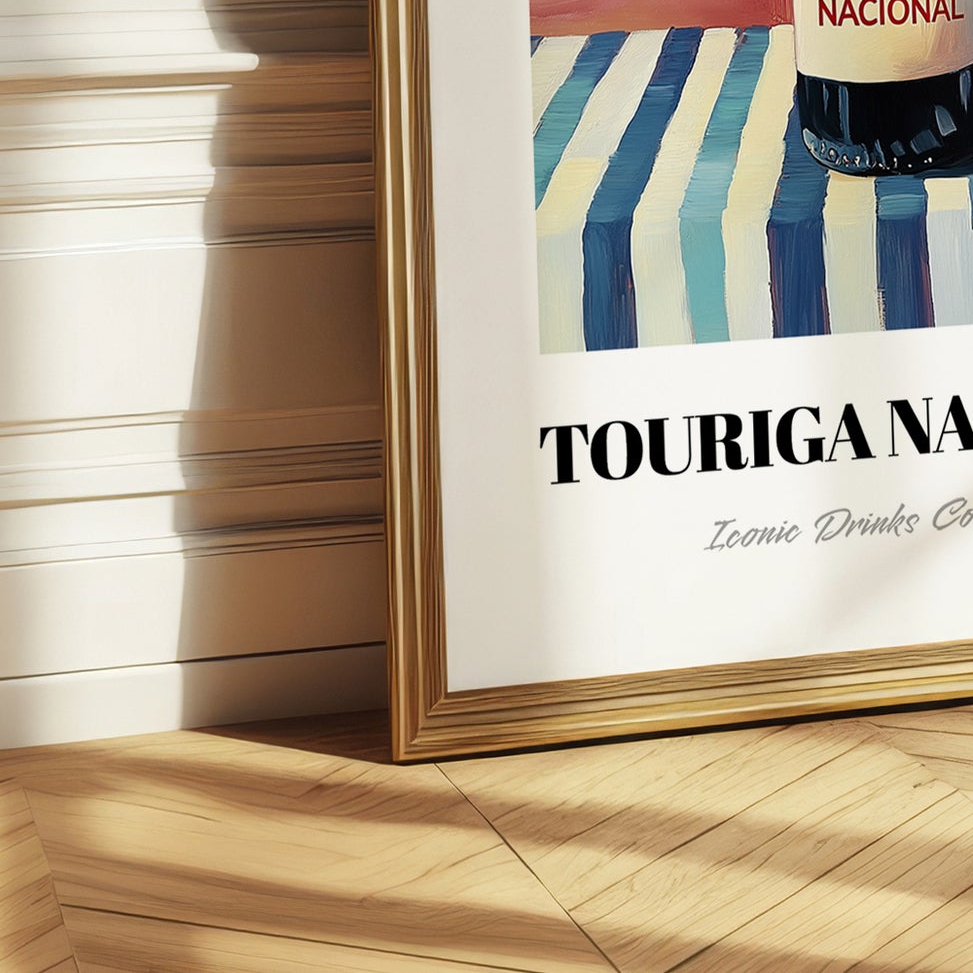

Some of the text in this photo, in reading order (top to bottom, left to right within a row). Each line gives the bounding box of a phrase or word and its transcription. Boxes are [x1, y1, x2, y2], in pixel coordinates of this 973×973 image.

[539, 403, 876, 485] TOURIGA
[703, 518, 802, 552] Iconic
[814, 503, 919, 544] Drinks
